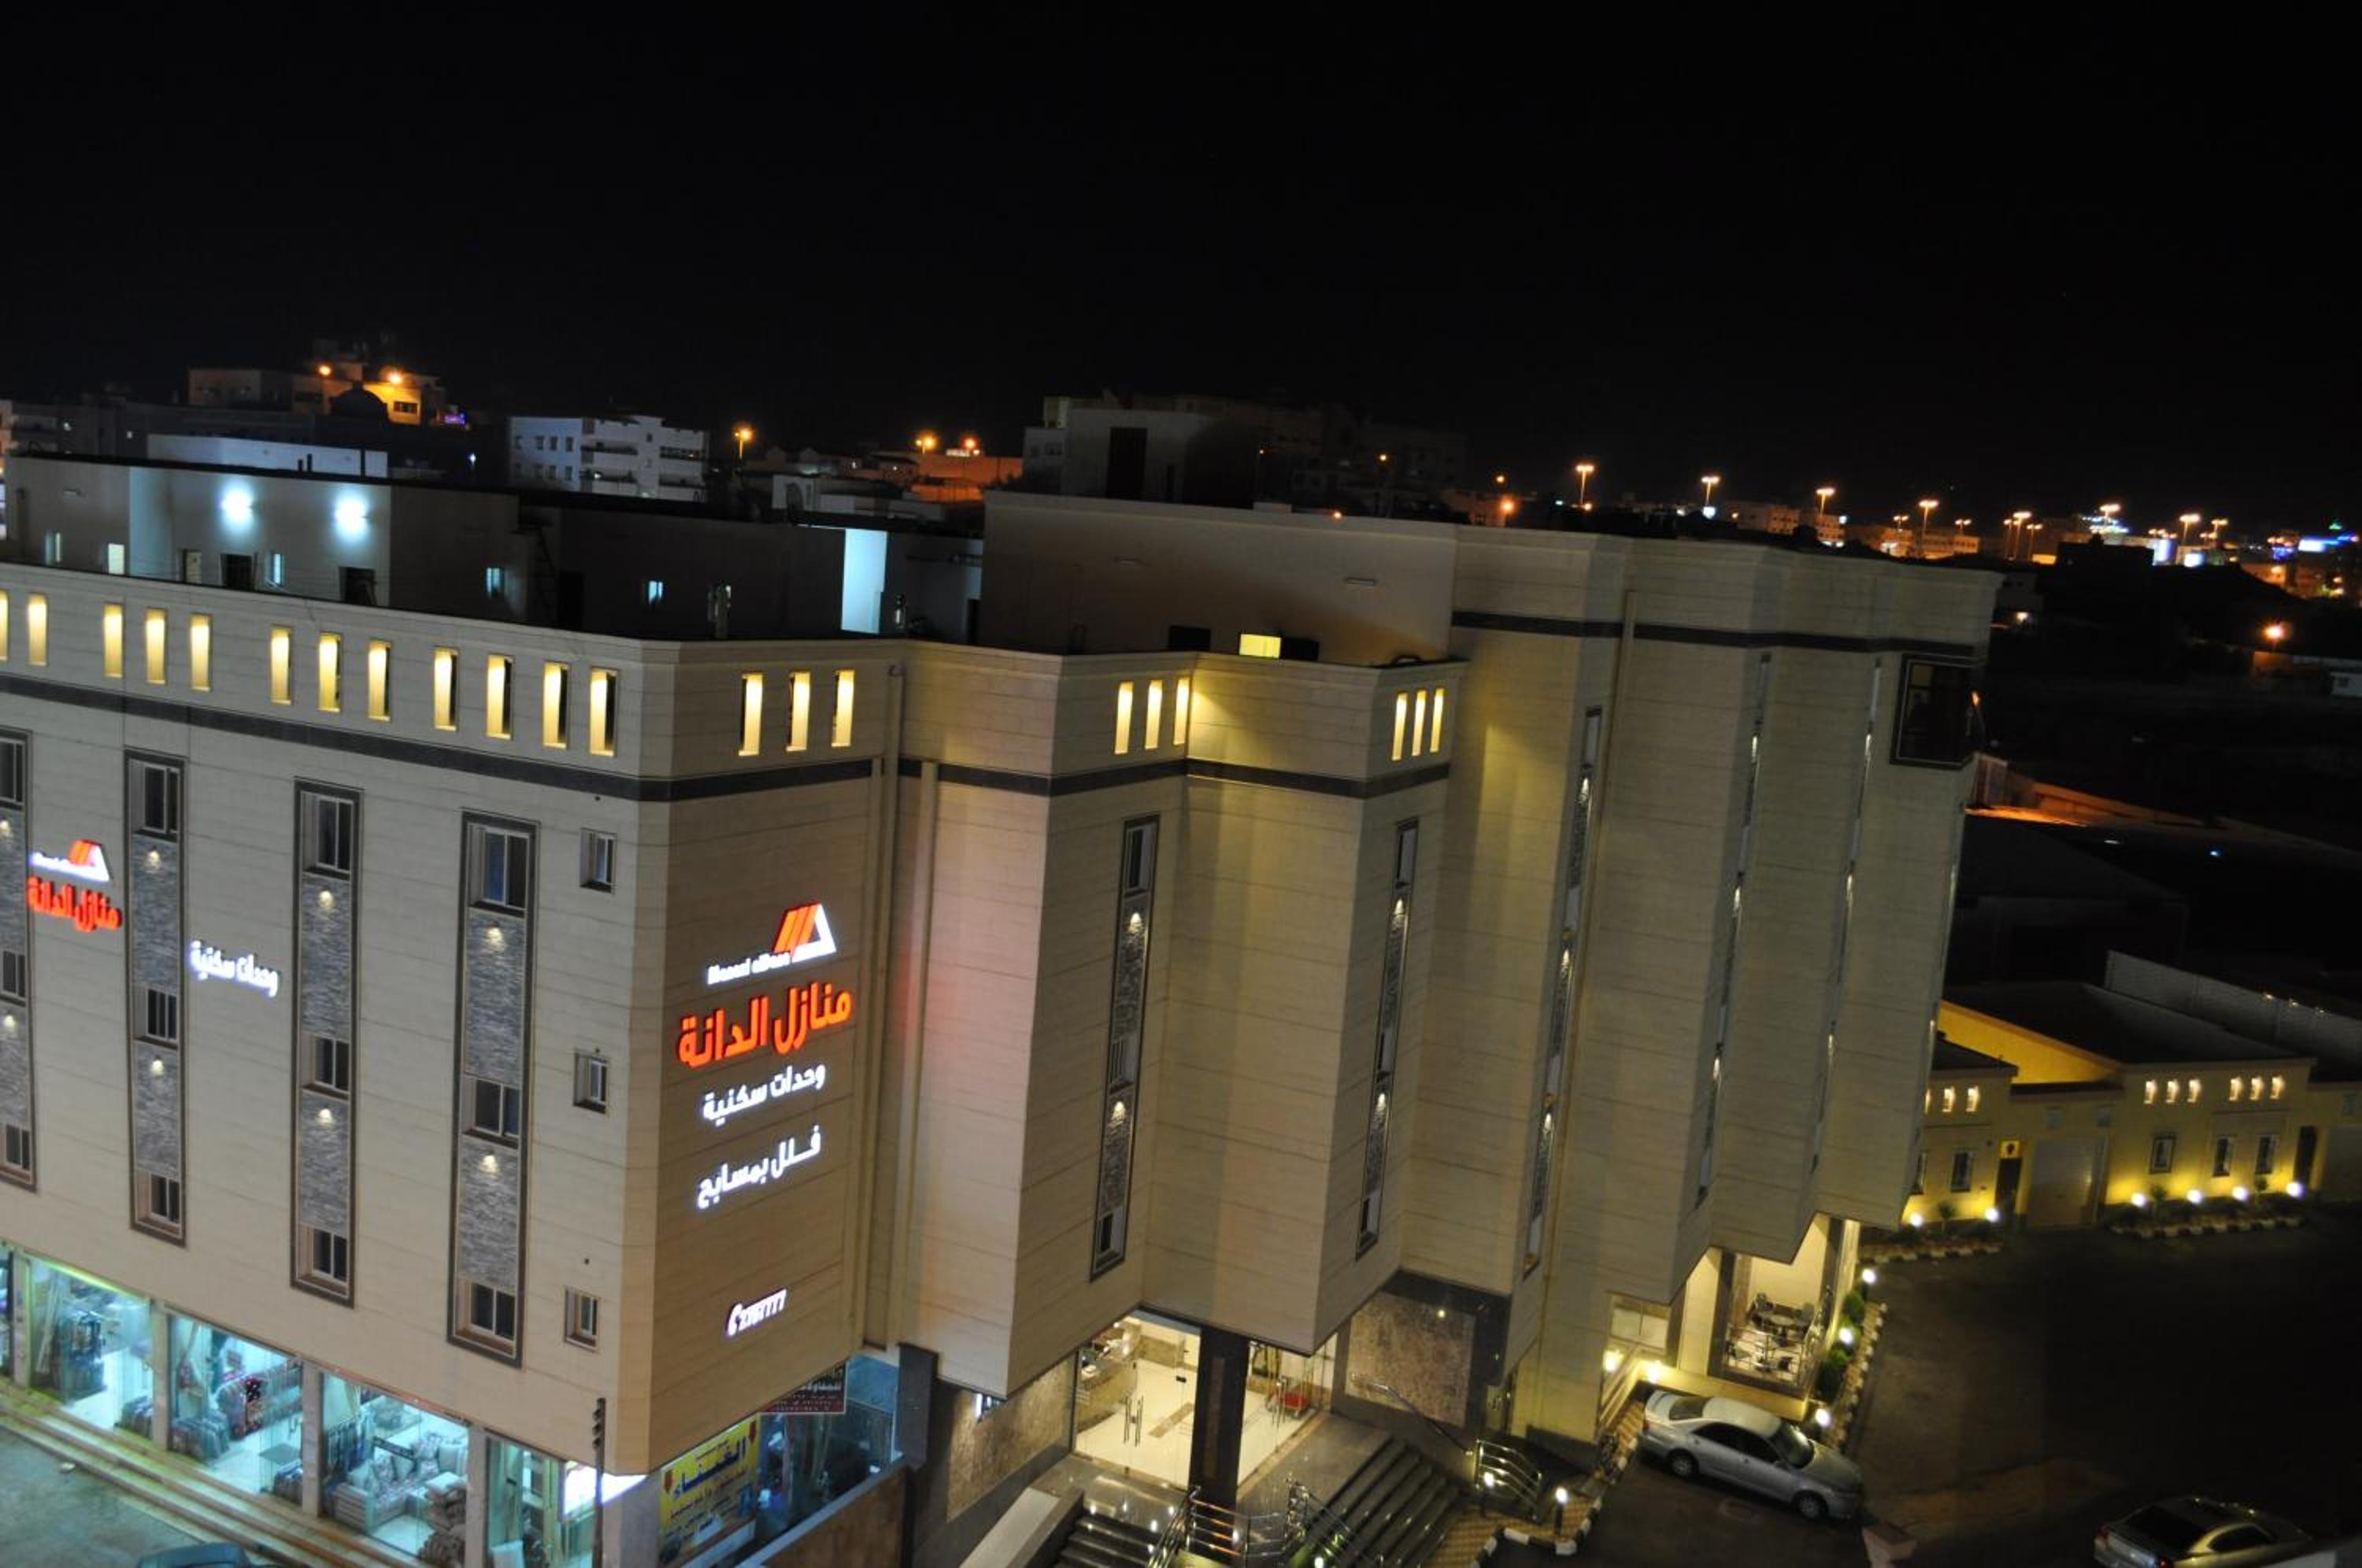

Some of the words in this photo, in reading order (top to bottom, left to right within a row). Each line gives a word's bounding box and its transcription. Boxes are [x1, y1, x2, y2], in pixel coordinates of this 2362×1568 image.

[677, 996, 770, 1069] الدانة
[774, 981, 853, 1055] منازل
[703, 1084, 768, 1127] سكنية
[770, 1062, 826, 1097] وحدات
[697, 1156, 769, 1210] بمسابح
